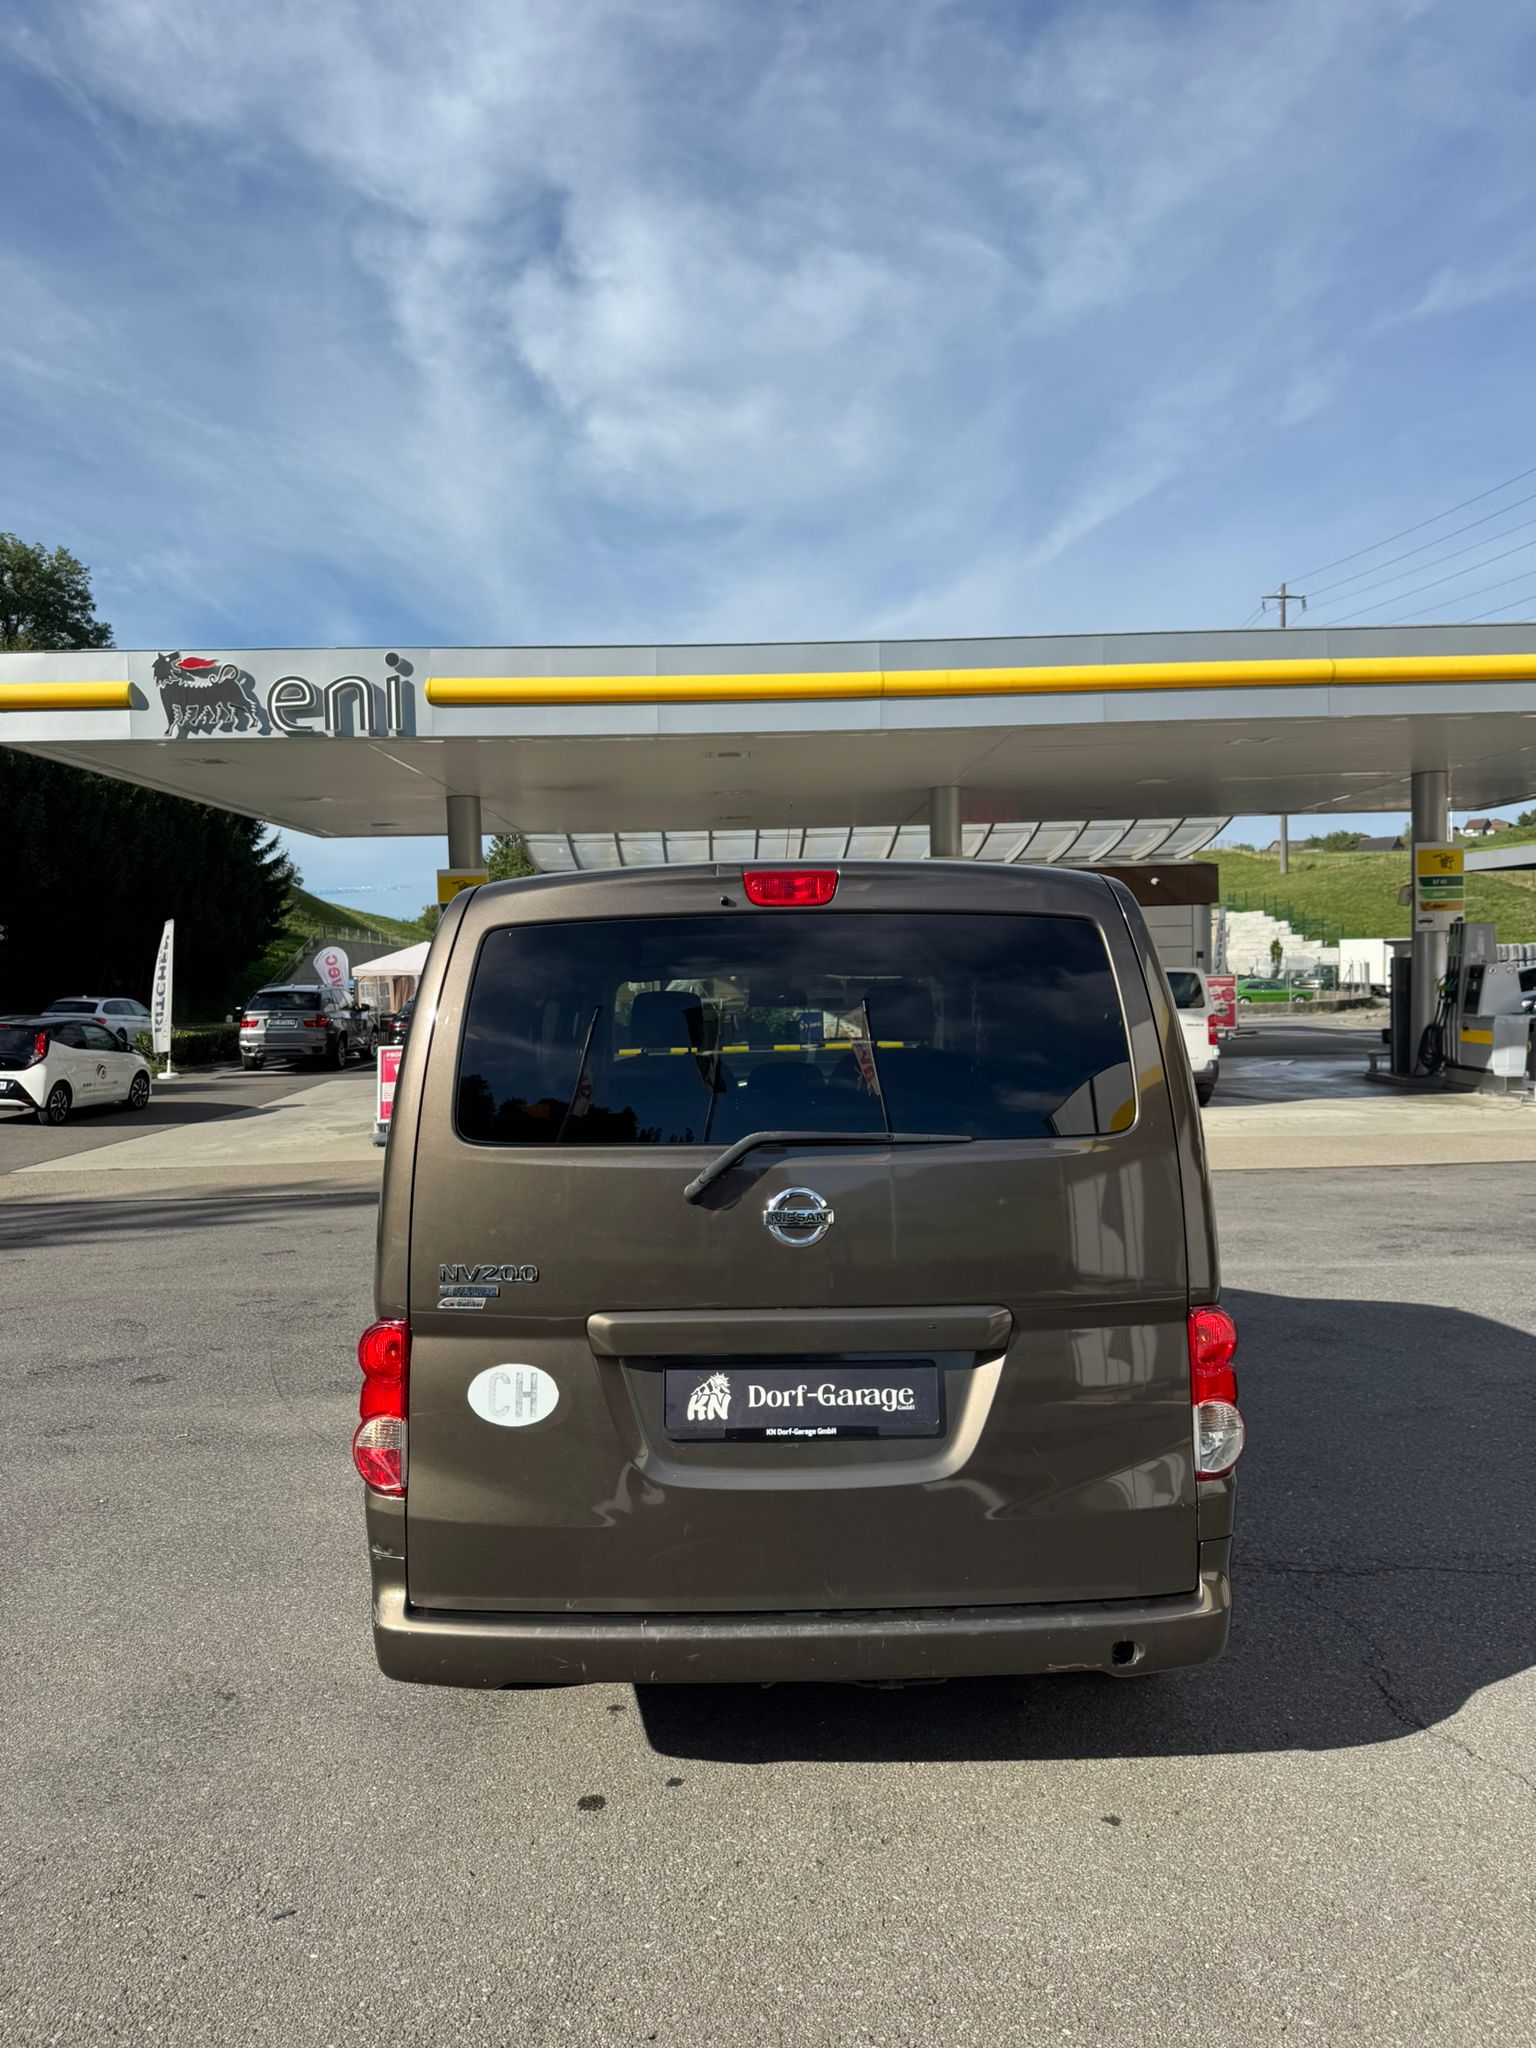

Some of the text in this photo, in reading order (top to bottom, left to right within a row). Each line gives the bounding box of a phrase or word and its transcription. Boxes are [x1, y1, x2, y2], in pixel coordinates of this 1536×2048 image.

[267, 652, 402, 732] eni
[771, 1212, 827, 1222] NISSAN
[440, 1264, 539, 1282] NV200
[489, 1372, 538, 1417] CH
[687, 1393, 732, 1420] KN
[748, 1384, 914, 1412] Dorf-Garage
[766, 1426, 837, 1437] KN Dorf-Garage GmbH
